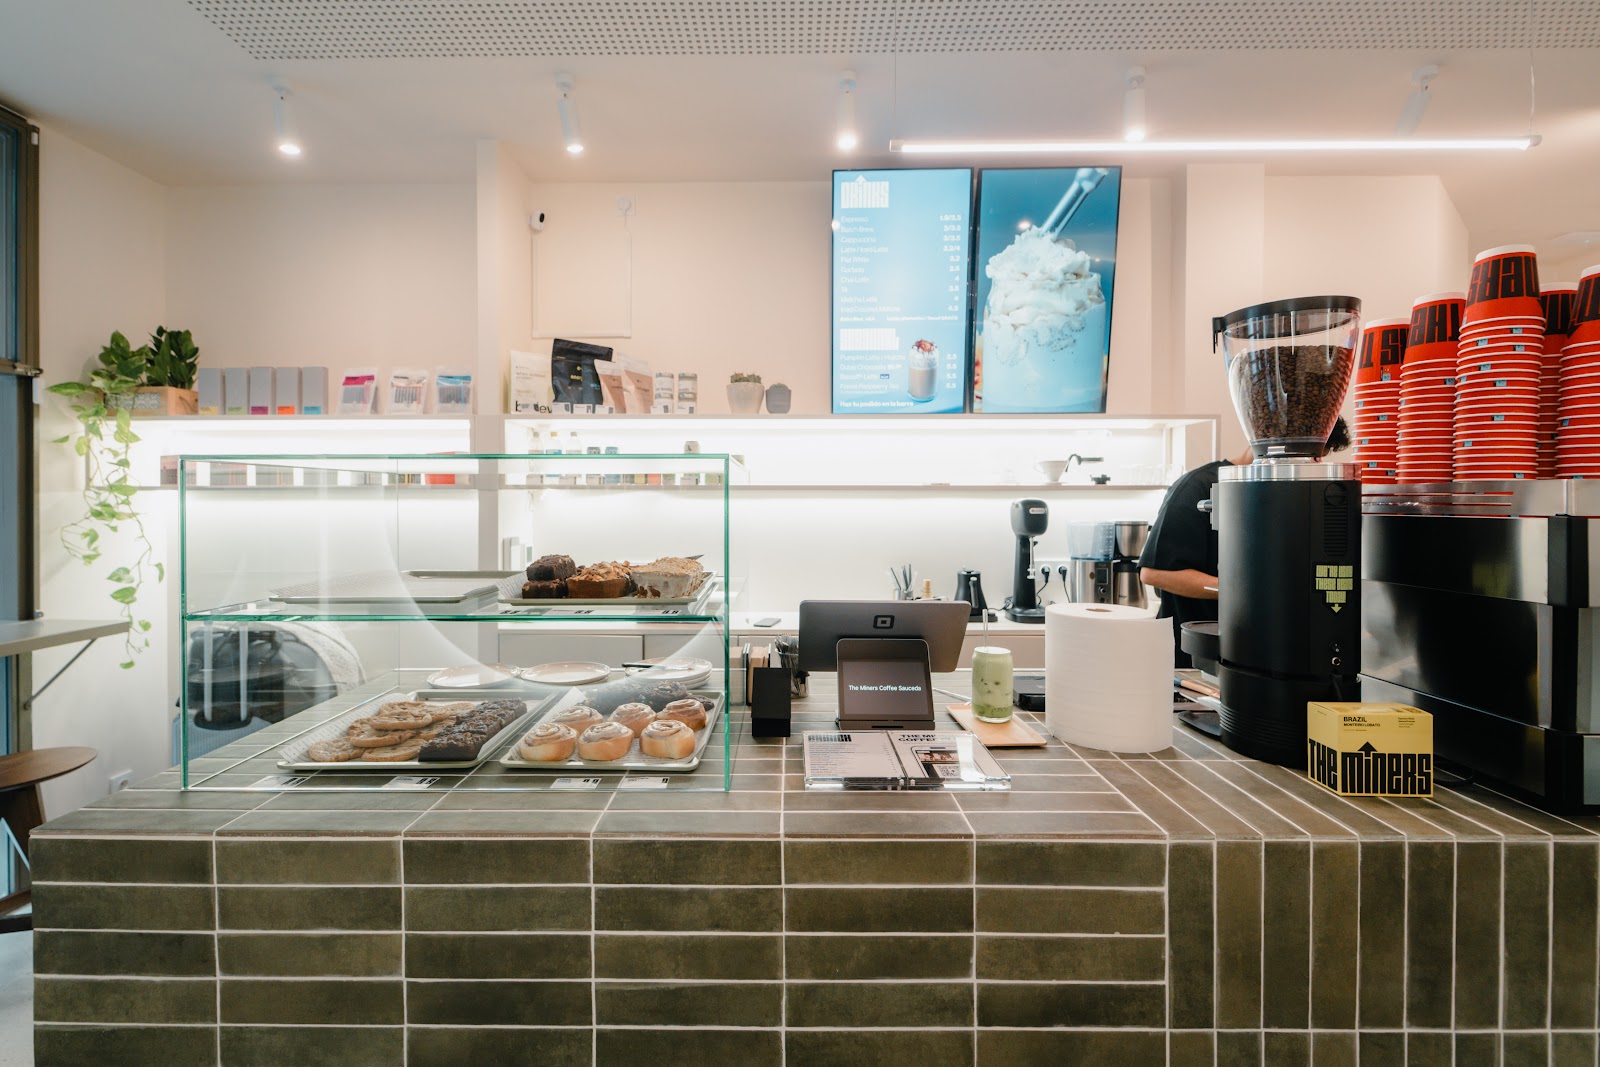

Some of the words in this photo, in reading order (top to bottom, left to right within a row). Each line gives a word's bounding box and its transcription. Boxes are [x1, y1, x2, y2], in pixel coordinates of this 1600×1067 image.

[879, 684, 897, 692] Coffee
[898, 684, 922, 692] Sauceda
[1308, 738, 1338, 792] THE
[1341, 741, 1432, 794] MINERS
